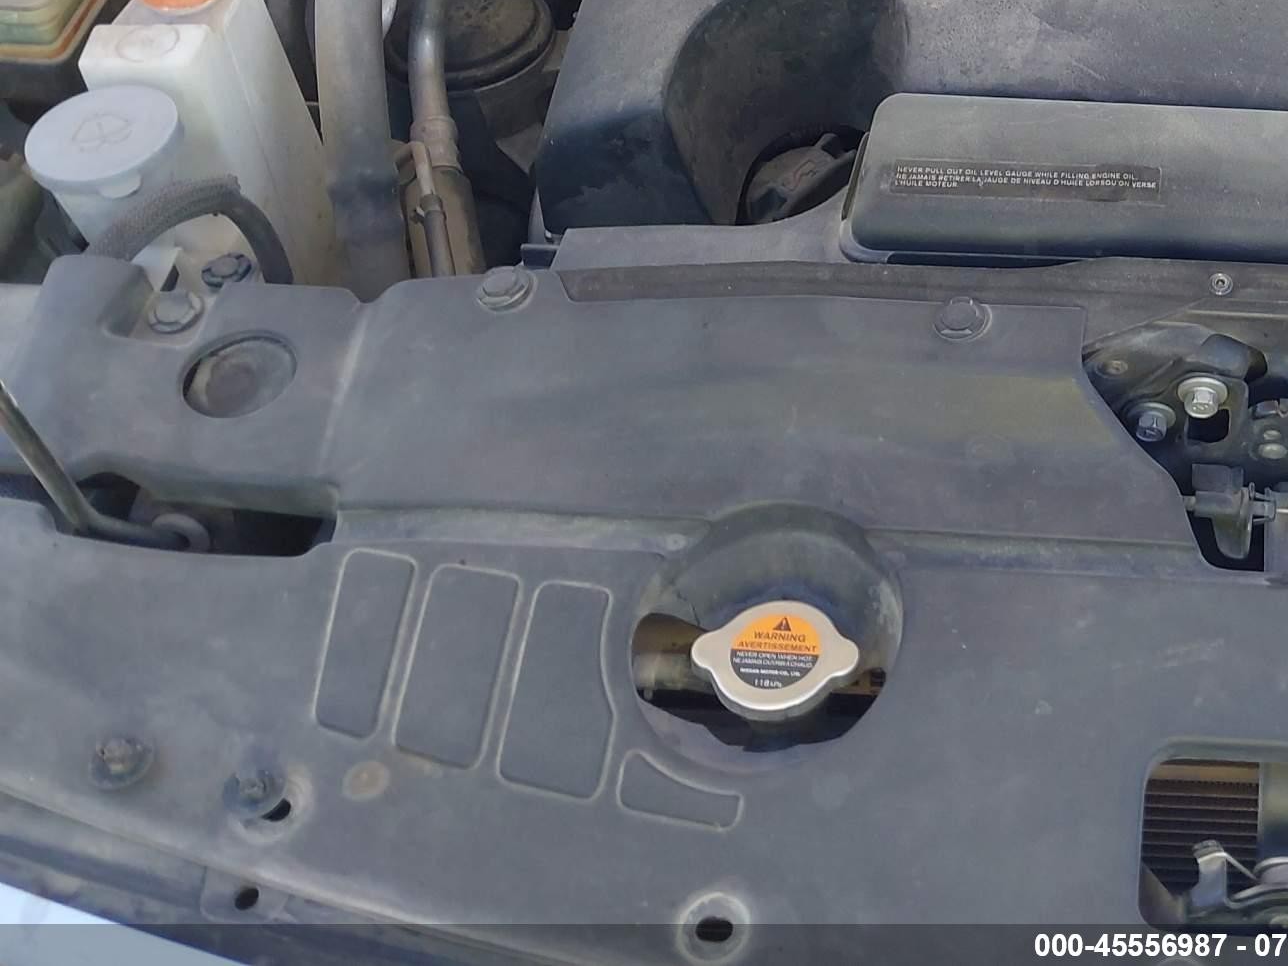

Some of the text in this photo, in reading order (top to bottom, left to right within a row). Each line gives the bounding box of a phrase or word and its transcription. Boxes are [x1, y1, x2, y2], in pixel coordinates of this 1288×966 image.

[897, 165, 923, 173] NEVER
[925, 167, 944, 175] PULL
[1005, 170, 1033, 178] GAUGE
[1035, 171, 1058, 179] WHILE
[754, 631, 806, 642] WARNING
[738, 641, 817, 652] AVERTISSEMENT
